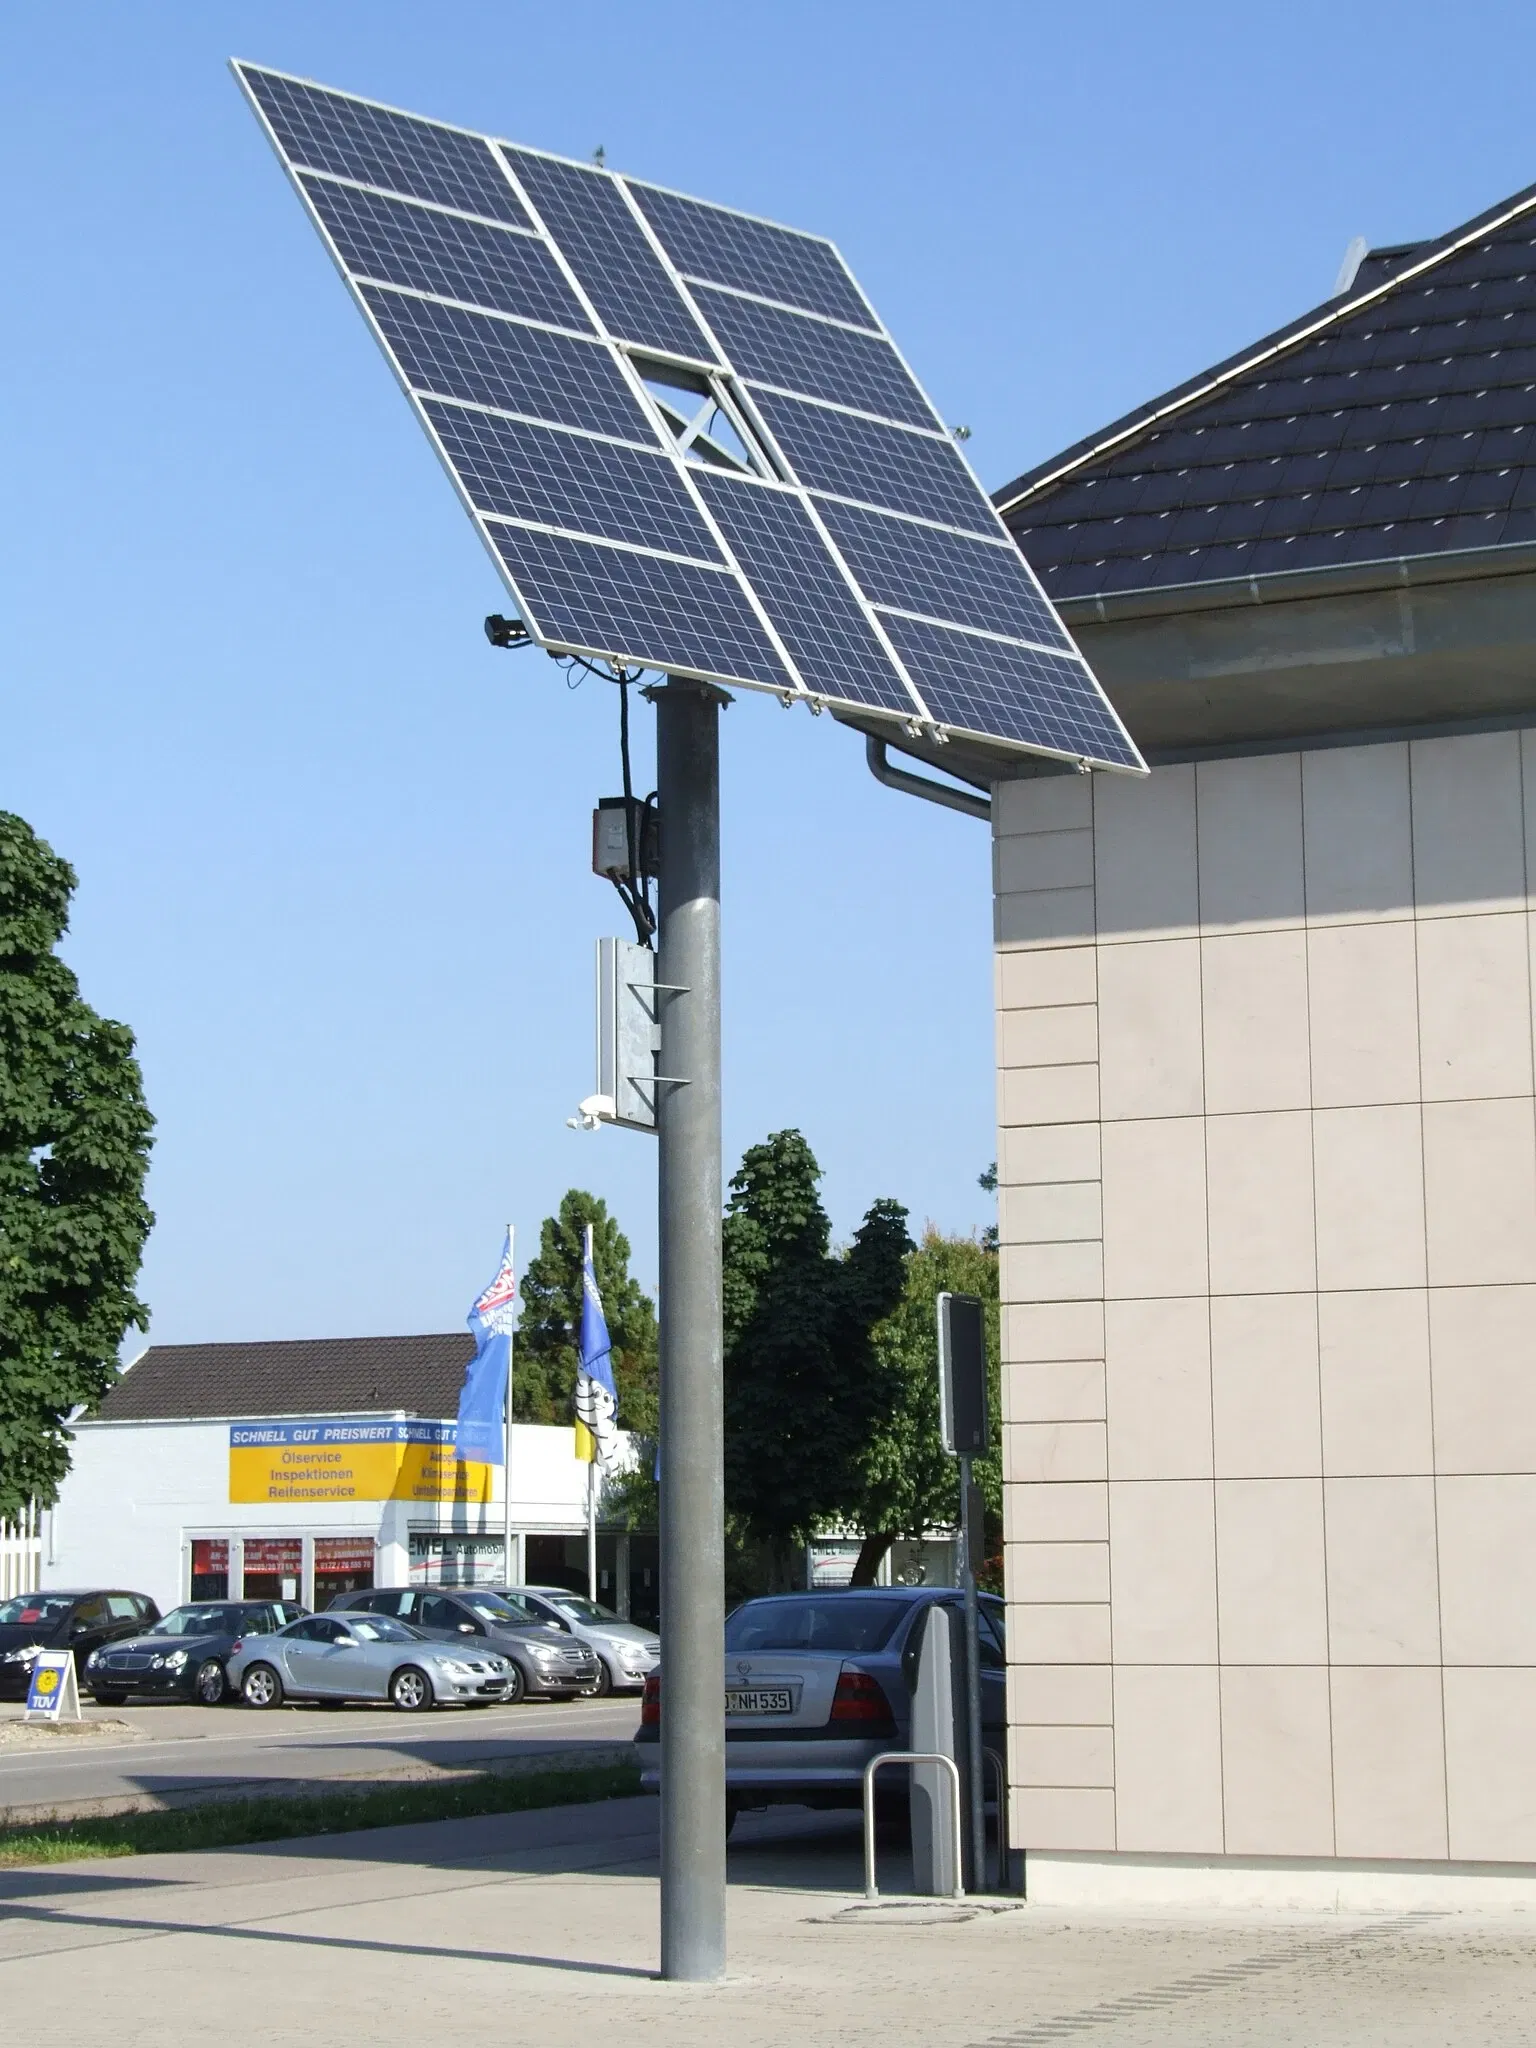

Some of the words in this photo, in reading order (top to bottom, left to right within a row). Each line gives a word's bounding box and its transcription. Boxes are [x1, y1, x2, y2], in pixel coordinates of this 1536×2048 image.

[233, 1429, 287, 1443] SCHNELL
[292, 1429, 319, 1442] GUT
[324, 1426, 394, 1441] PREISWERT
[398, 1426, 432, 1440] SCHNELL
[434, 1429, 450, 1441] GUT
[281, 1449, 342, 1464] Ölservice
[270, 1468, 353, 1482] Inspektionen
[268, 1485, 356, 1499] Reifenservice
